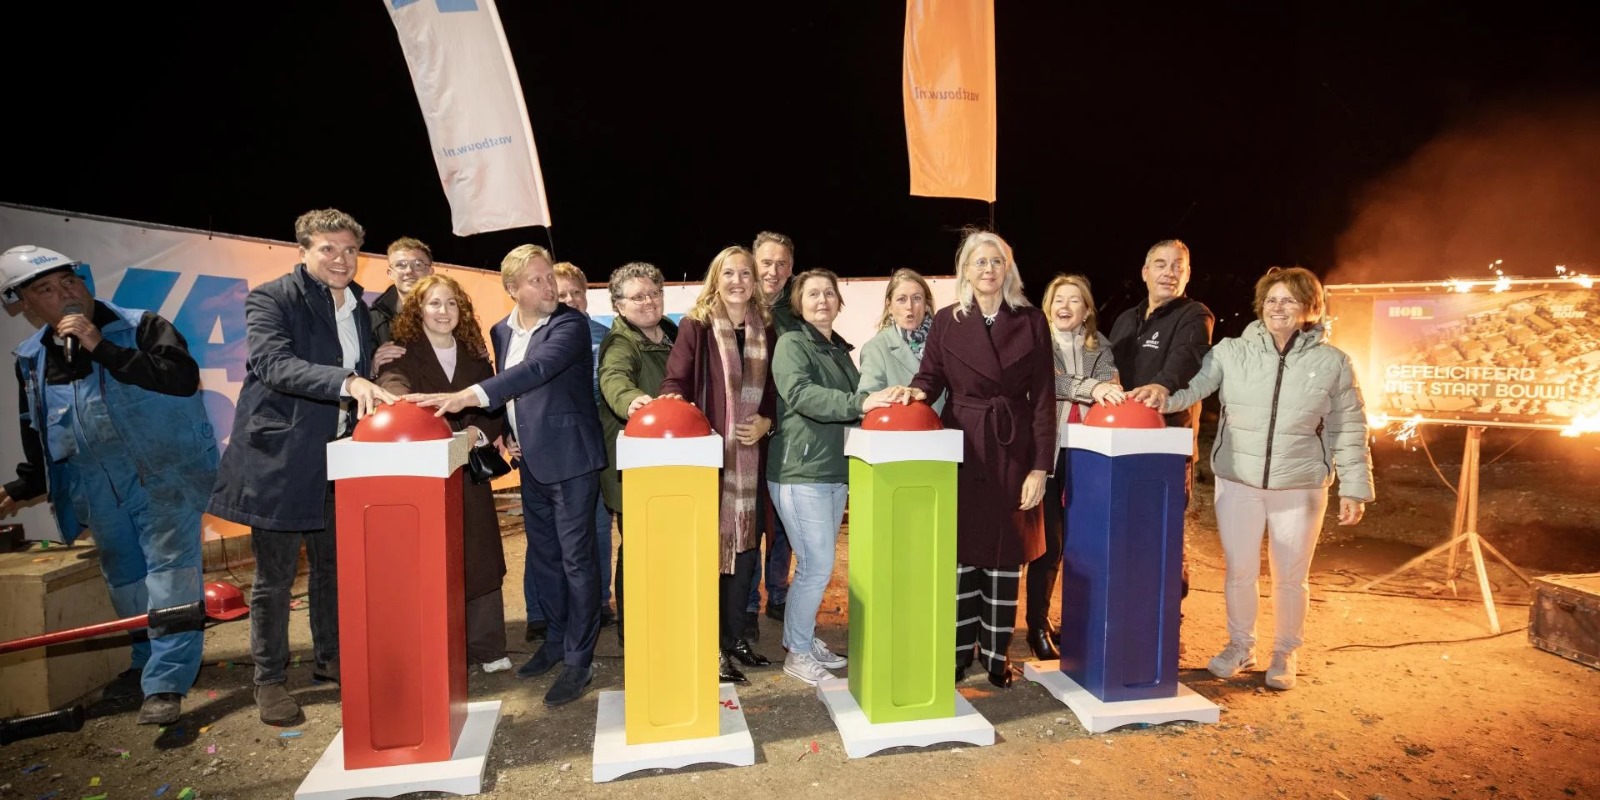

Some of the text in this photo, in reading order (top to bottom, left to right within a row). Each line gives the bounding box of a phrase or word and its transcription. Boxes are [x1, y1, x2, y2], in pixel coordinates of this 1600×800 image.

[1386, 365, 1535, 381] GEFELICITEERD
[1384, 380, 1566, 399] MET START BOUW!
